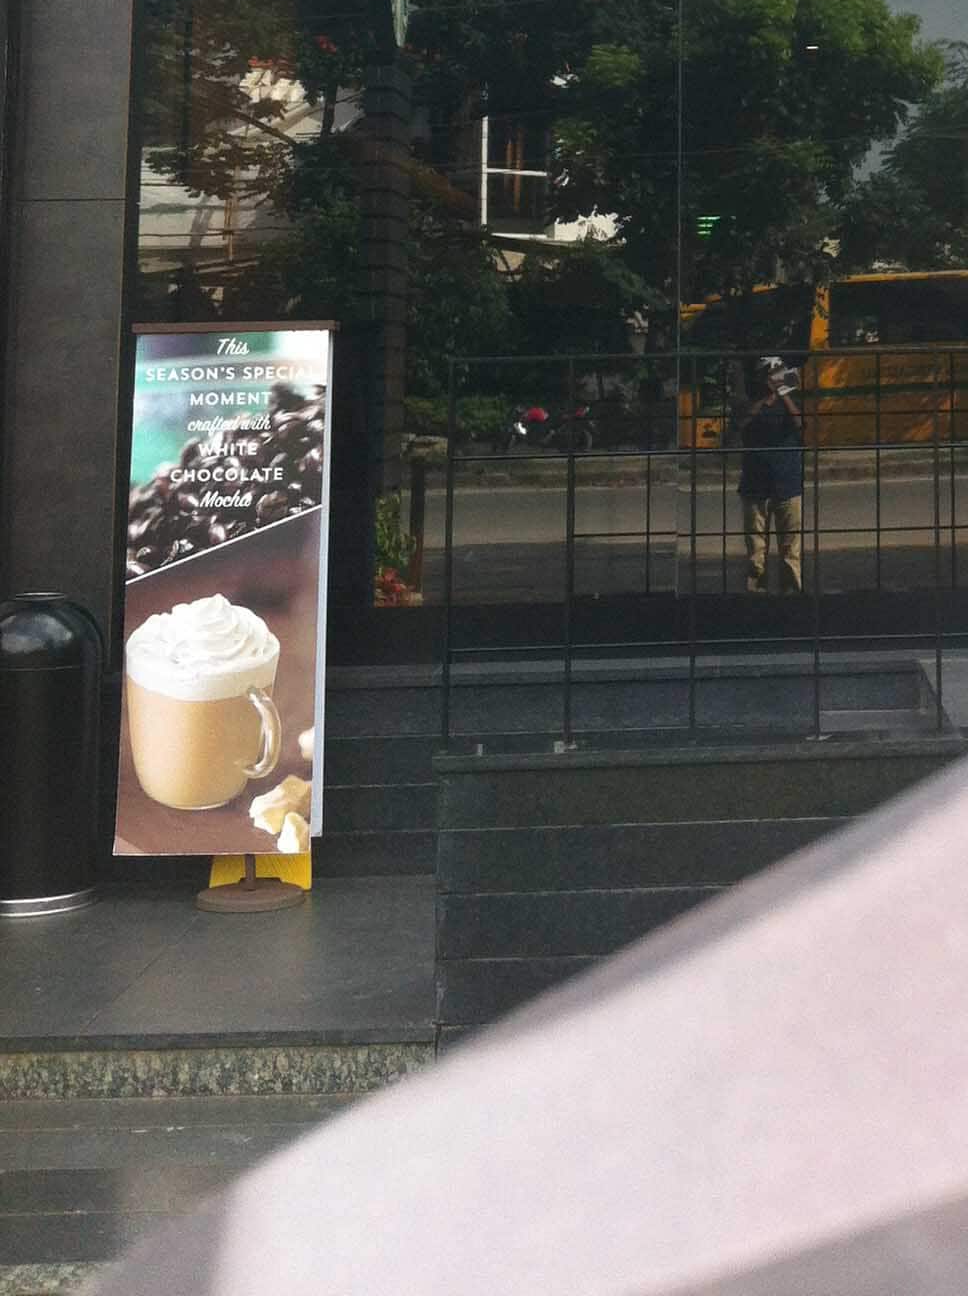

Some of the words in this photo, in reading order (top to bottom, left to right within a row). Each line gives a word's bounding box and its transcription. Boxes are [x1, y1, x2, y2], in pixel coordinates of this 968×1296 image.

[216, 337, 249, 356] This
[145, 366, 236, 382] SEASON'S
[242, 366, 314, 381] SPECIAL
[190, 391, 272, 406] MOMENT
[187, 415, 240, 437] crafted
[240, 414, 272, 431] with
[198, 442, 259, 457] WHITE
[170, 467, 285, 483] CHOCOLATE
[199, 489, 253, 508] Mocha
